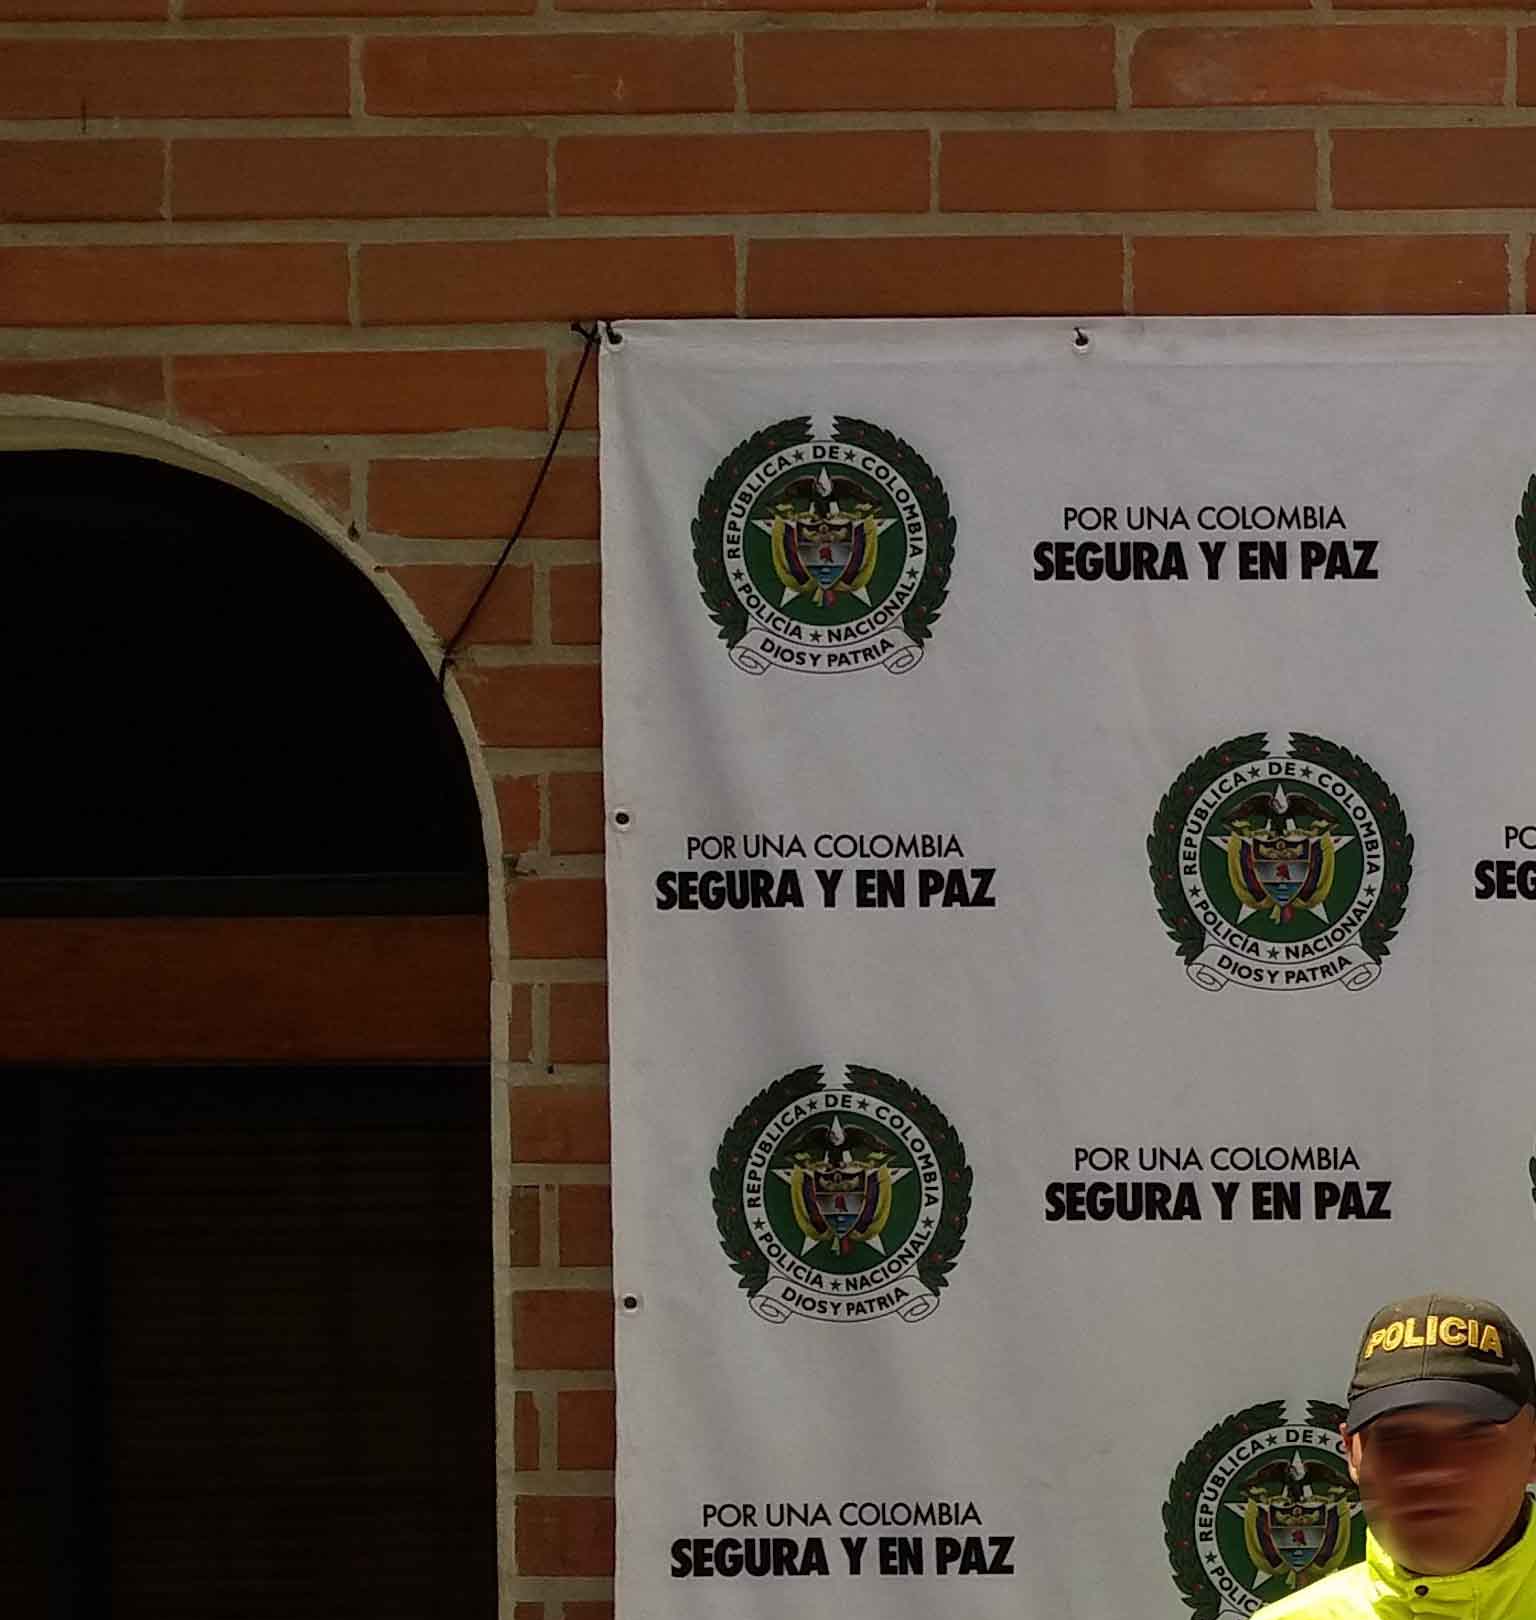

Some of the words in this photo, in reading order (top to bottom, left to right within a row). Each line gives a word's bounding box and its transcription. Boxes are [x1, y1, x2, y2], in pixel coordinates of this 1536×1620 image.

[812, 446, 840, 460] DE
[862, 456, 923, 558] COLOMBIA
[1063, 506, 1120, 532] POR
[1125, 505, 1192, 532] UNA
[1196, 504, 1348, 531] COLOMBIA
[1032, 540, 1190, 582] SEGURA
[1197, 540, 1231, 581] Y
[1237, 539, 1288, 581] EN
[1299, 539, 1381, 581] PAZ
[827, 576, 916, 644] NACIONAL
[827, 639, 894, 668] PATRIA
[686, 834, 739, 861] POR
[742, 832, 808, 859] UNA
[813, 832, 966, 859] COLOMBIA
[654, 867, 805, 911] SEGURA
[813, 868, 845, 909] Y
[854, 868, 906, 909] EN
[917, 867, 998, 909] PAZ
[1364, 1315, 1504, 1360] POLICIA
[702, 1503, 759, 1529] POR
[765, 1502, 833, 1528] UNA
[838, 1500, 983, 1527] COLOMBIA
[669, 1536, 831, 1579] SEGURA
[839, 1535, 869, 1576] Y
[877, 1536, 925, 1576] EN
[934, 1535, 1016, 1576] PAZ
